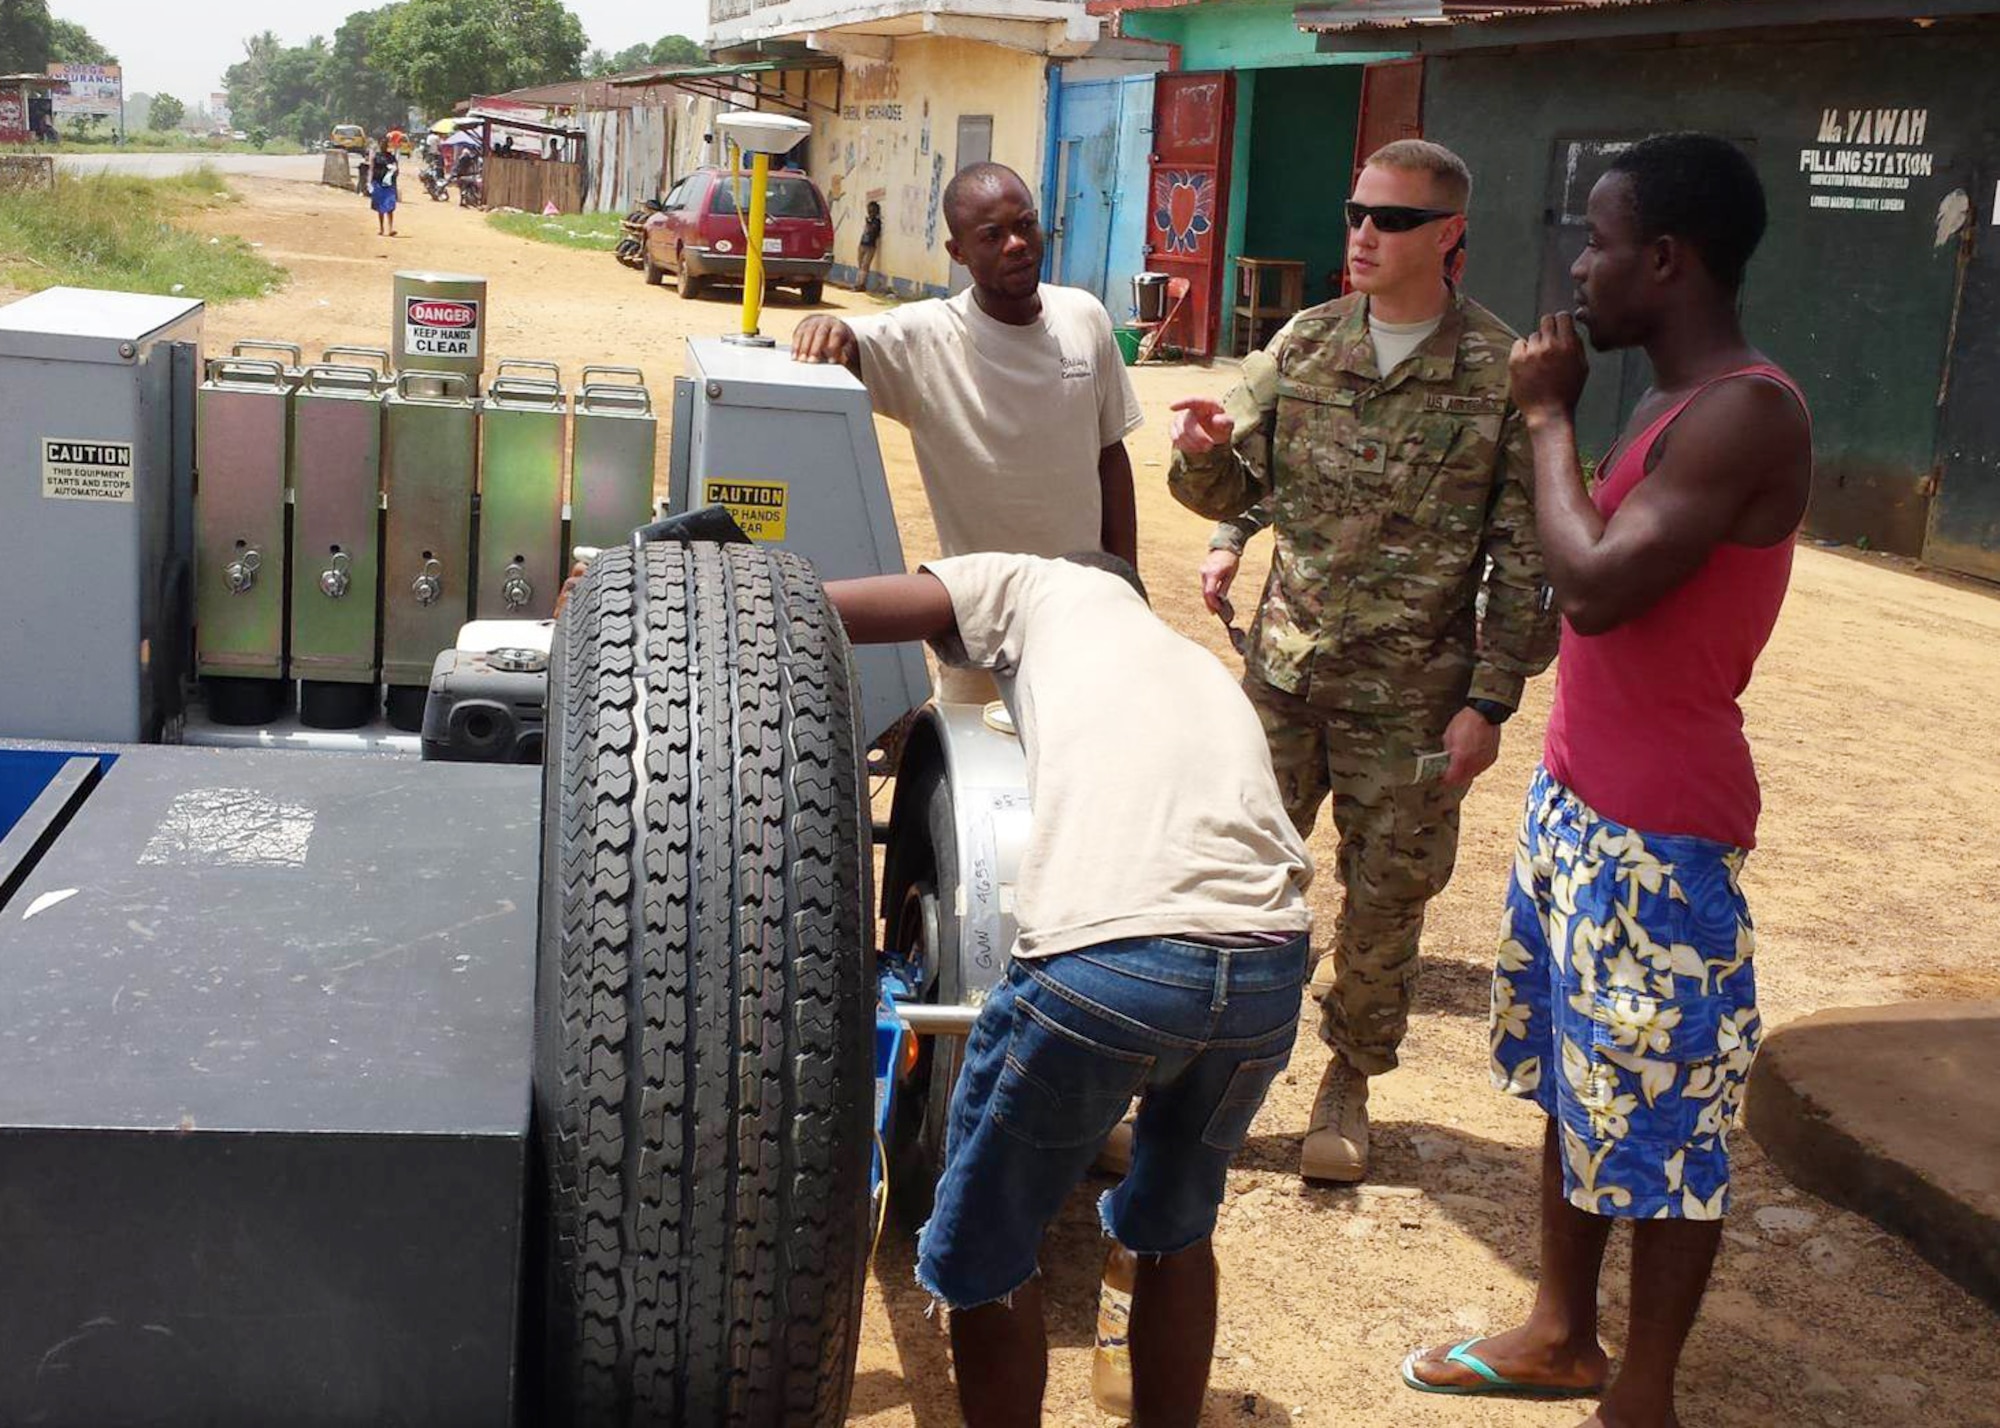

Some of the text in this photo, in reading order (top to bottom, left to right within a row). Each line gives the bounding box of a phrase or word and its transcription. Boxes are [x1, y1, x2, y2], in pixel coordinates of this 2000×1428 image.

[1799, 149, 1933, 176] FILLING STATION
[415, 306, 471, 323] DANGER
[414, 326, 471, 340] KEEP HANDS
[416, 339, 468, 353] CLEAR
[48, 444, 130, 465] CAUTION
[53, 467, 125, 479] THIS EQUIPMENT
[47, 477, 131, 489] STARTS AND STOPS
[54, 487, 124, 498] AUTOMATICALLY
[709, 486, 783, 505] CAUTION
[741, 509, 781, 522] HANDS
[740, 522, 763, 533] EAR
